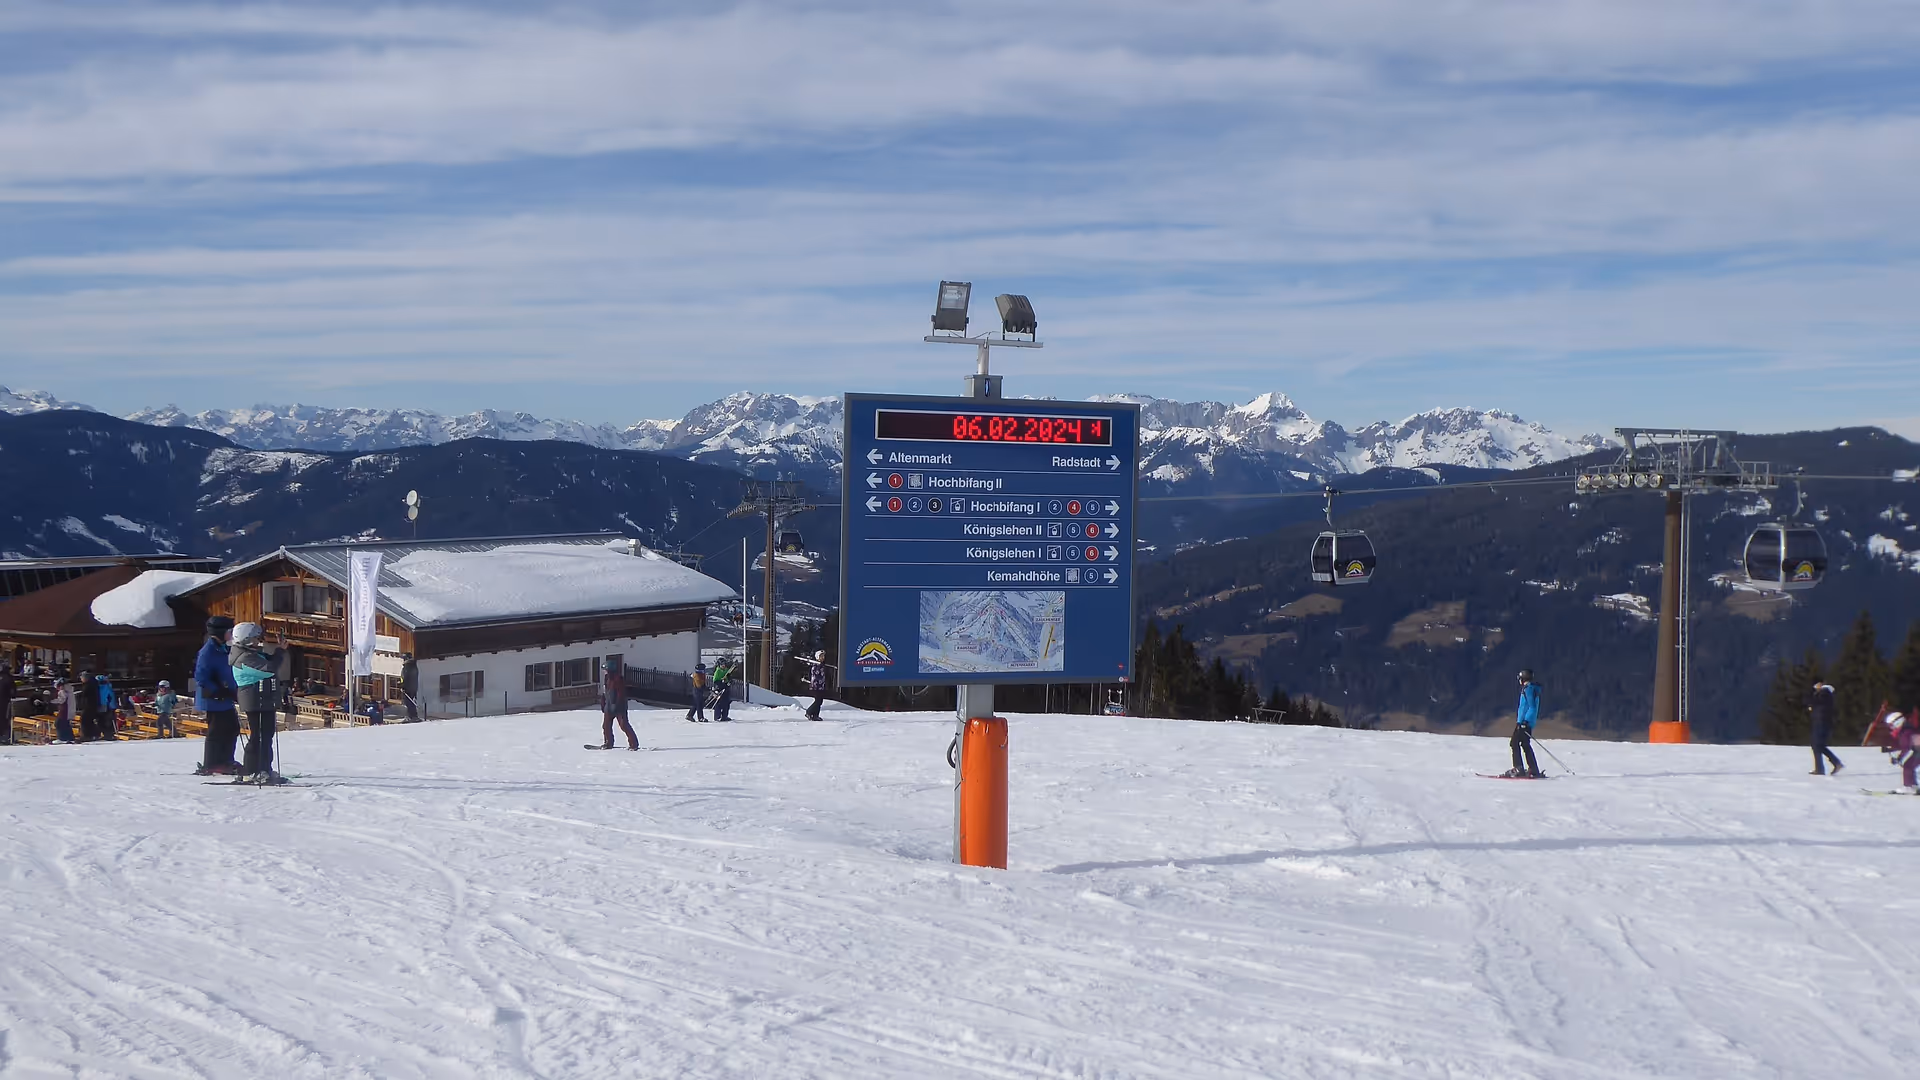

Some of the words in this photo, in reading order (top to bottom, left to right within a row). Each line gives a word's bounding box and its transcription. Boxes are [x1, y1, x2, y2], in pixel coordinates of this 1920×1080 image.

[953, 415, 1081, 442] 06.02.2024
[888, 452, 952, 465] Altenmarkt
[1052, 456, 1101, 468] Radstadt
[928, 476, 994, 491] Hochbifang
[970, 500, 1034, 515] Hochbifang
[963, 524, 1033, 538] Königslehen
[966, 547, 1036, 561] Königslehen
[987, 570, 1061, 582] Kemahdhöhe
